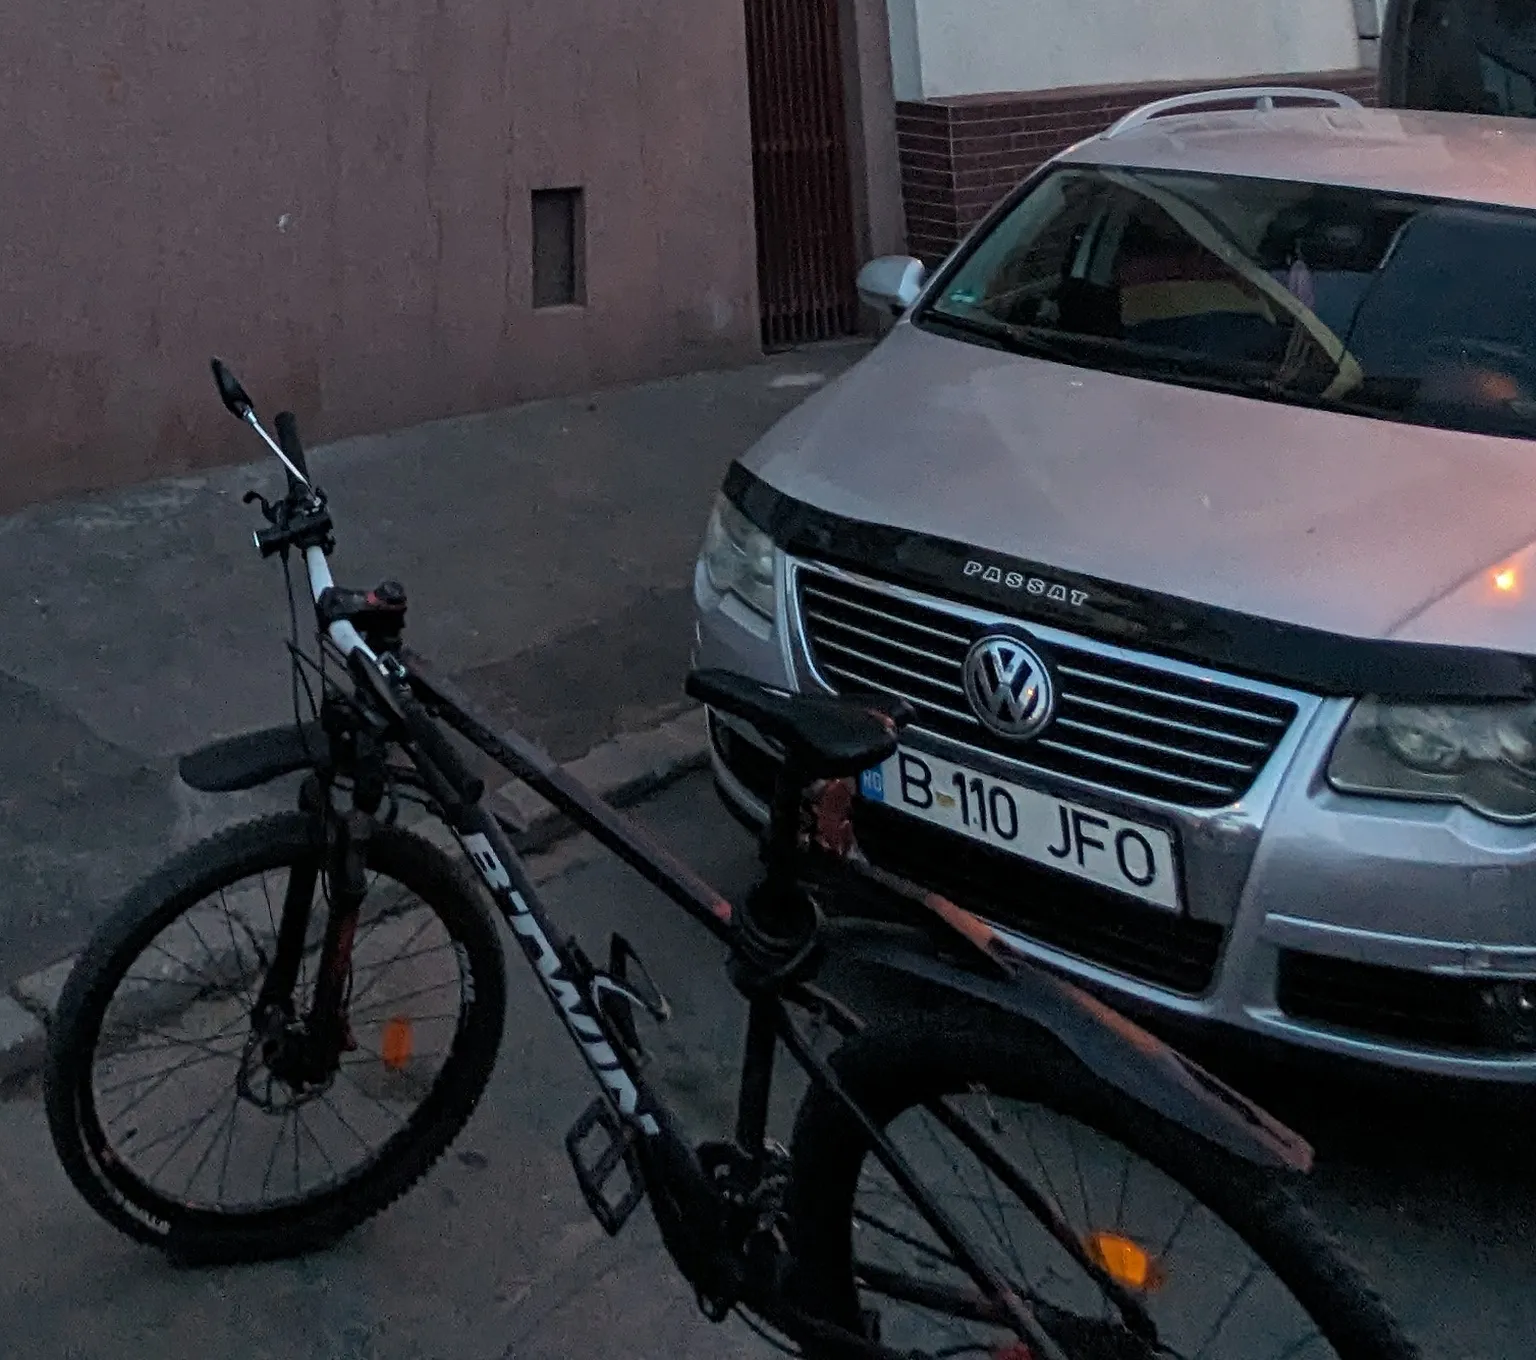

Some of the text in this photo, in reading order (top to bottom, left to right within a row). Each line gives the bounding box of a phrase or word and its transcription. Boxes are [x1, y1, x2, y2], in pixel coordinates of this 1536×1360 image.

[964, 560, 1088, 606] PASSAT
[899, 751, 934, 810] B
[951, 771, 1019, 840] 110
[1046, 804, 1157, 887] JFO
